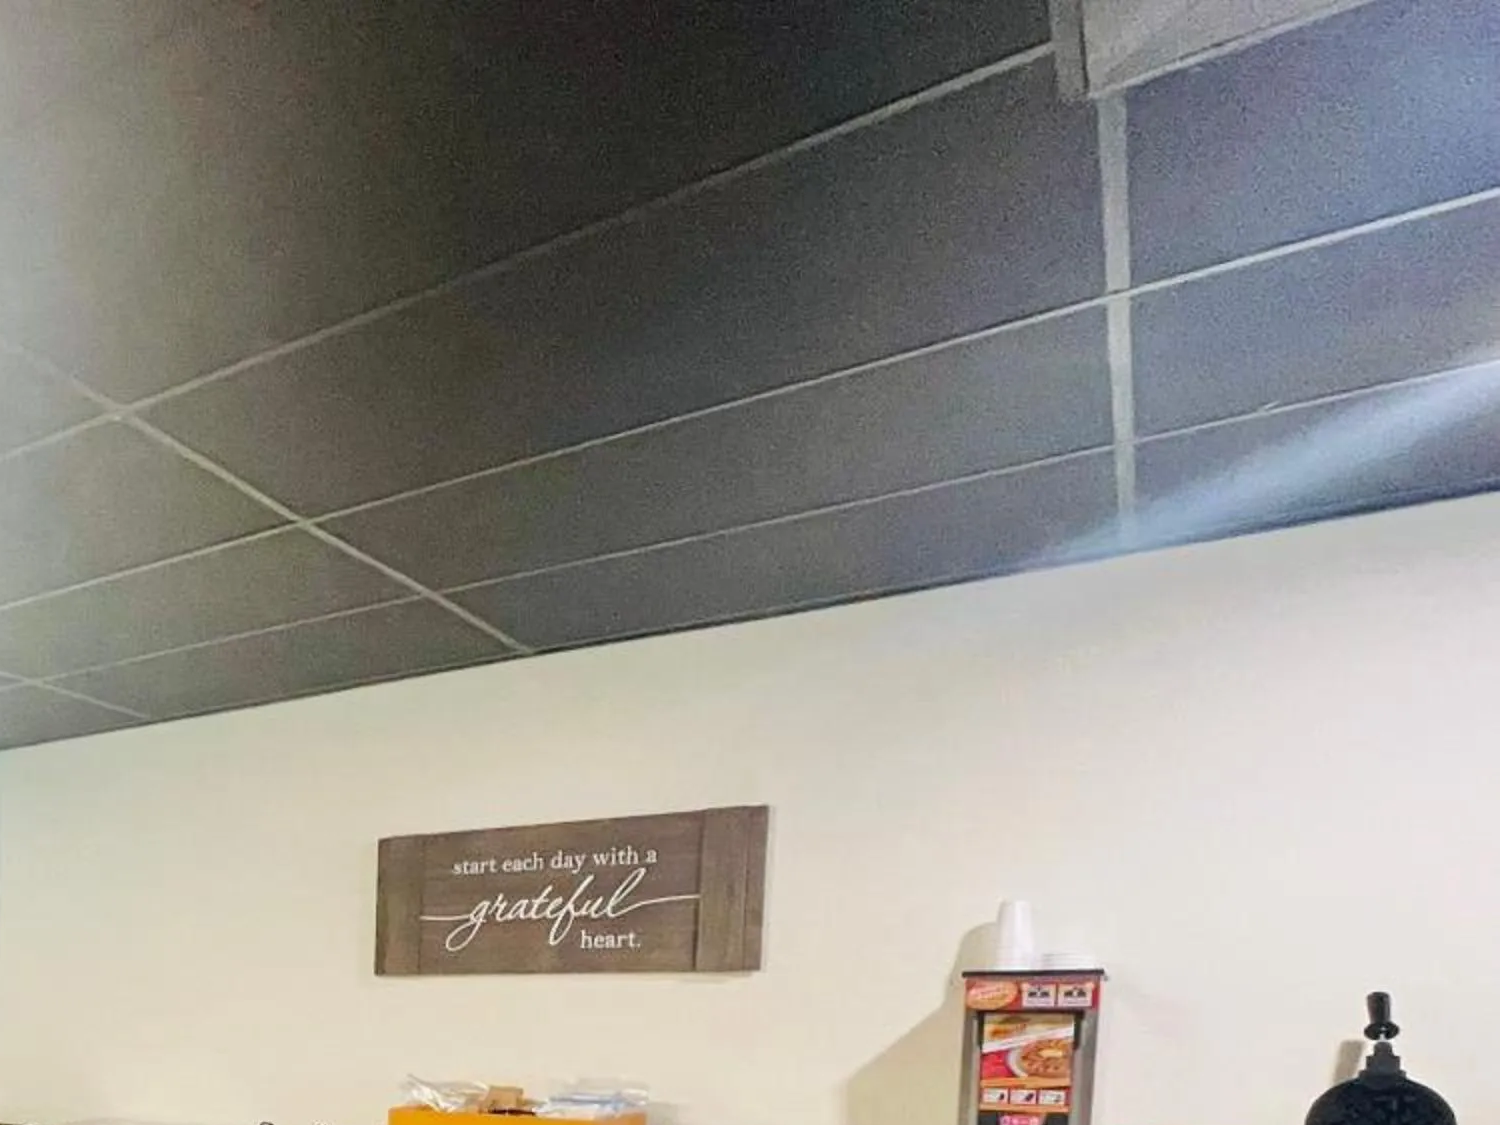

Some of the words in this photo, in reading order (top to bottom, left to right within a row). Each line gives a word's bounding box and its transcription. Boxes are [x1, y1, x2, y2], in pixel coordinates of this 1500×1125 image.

[452, 858, 497, 875] start
[502, 852, 544, 873] each
[551, 850, 586, 874] day
[593, 845, 639, 866] with
[645, 849, 658, 864] a
[421, 867, 700, 951] grateful
[580, 929, 641, 949] heart.
